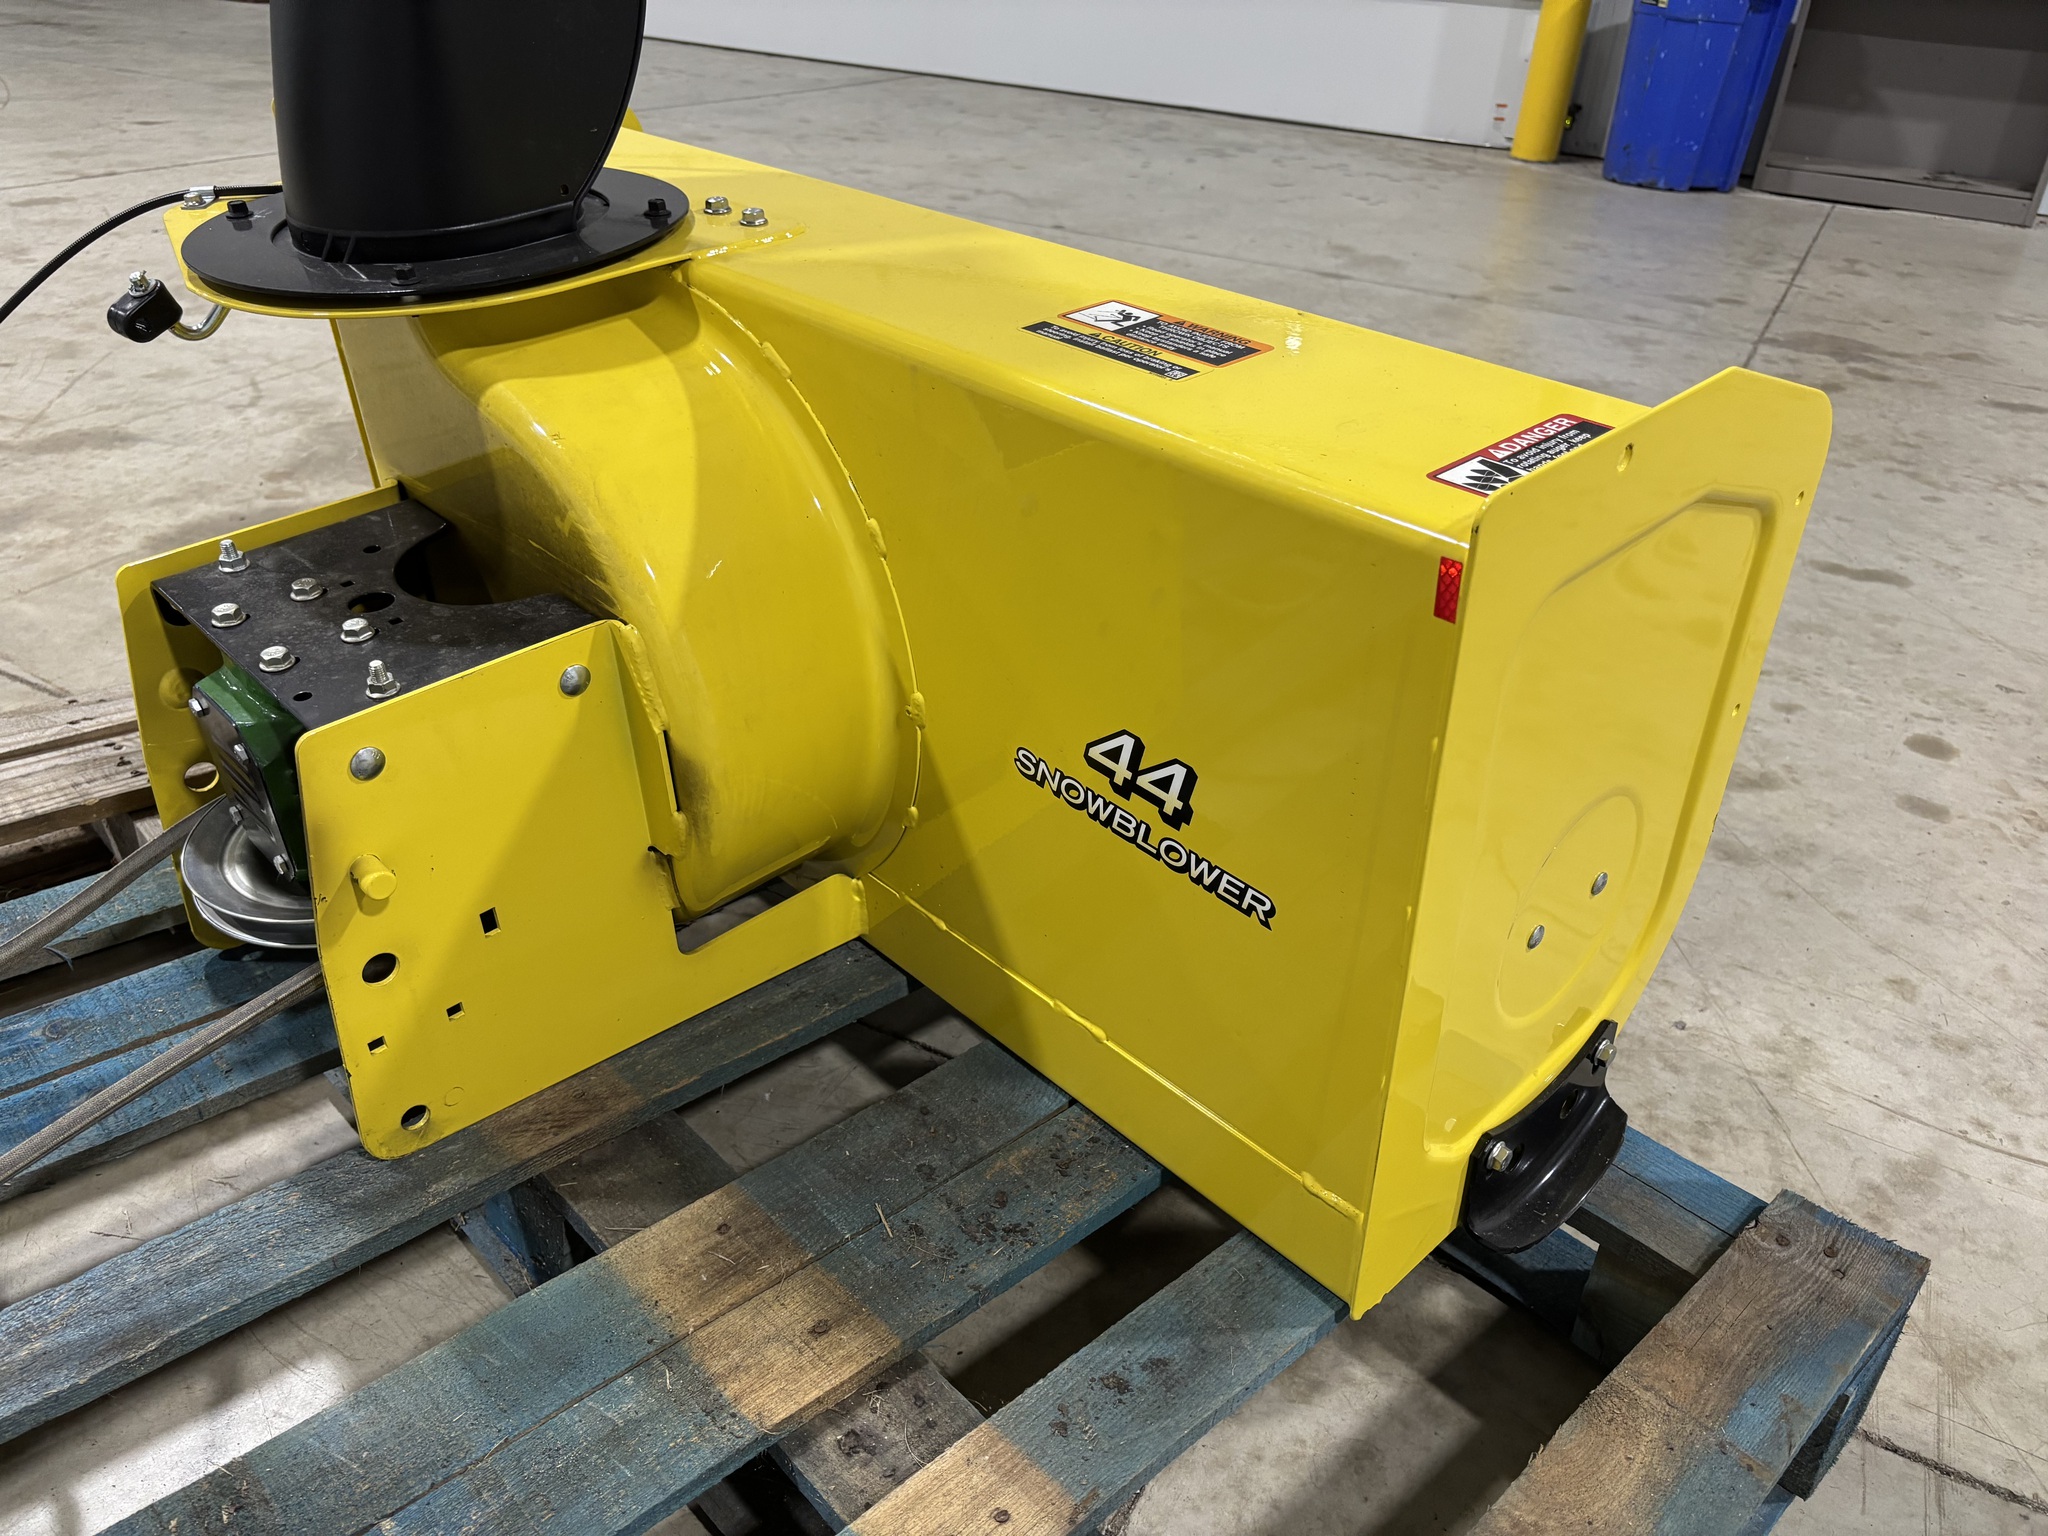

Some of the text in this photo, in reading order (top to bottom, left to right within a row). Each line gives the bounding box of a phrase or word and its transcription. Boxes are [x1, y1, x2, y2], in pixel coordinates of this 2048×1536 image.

[1079, 335, 1099, 343] injury
[1102, 336, 1162, 356] CAUTION
[1146, 326, 1166, 334] Read
[1203, 344, 1233, 354] manual
[1159, 326, 1229, 349] THROWN OBJECTS
[1168, 325, 1192, 334] AVOID
[1192, 332, 1220, 342] INJURY
[1220, 340, 1245, 350] FROM
[1188, 324, 1251, 345] WARNING
[1205, 349, 1226, 357] place
[1498, 418, 1578, 453] DANGER
[1517, 447, 1541, 460] avoid
[1536, 438, 1563, 450] injury
[1558, 430, 1580, 440] from
[1516, 453, 1551, 468] rotating
[1568, 433, 1592, 444] keep
[1084, 729, 1198, 831] 44
[1014, 747, 1276, 931] SNOWBLOWER
